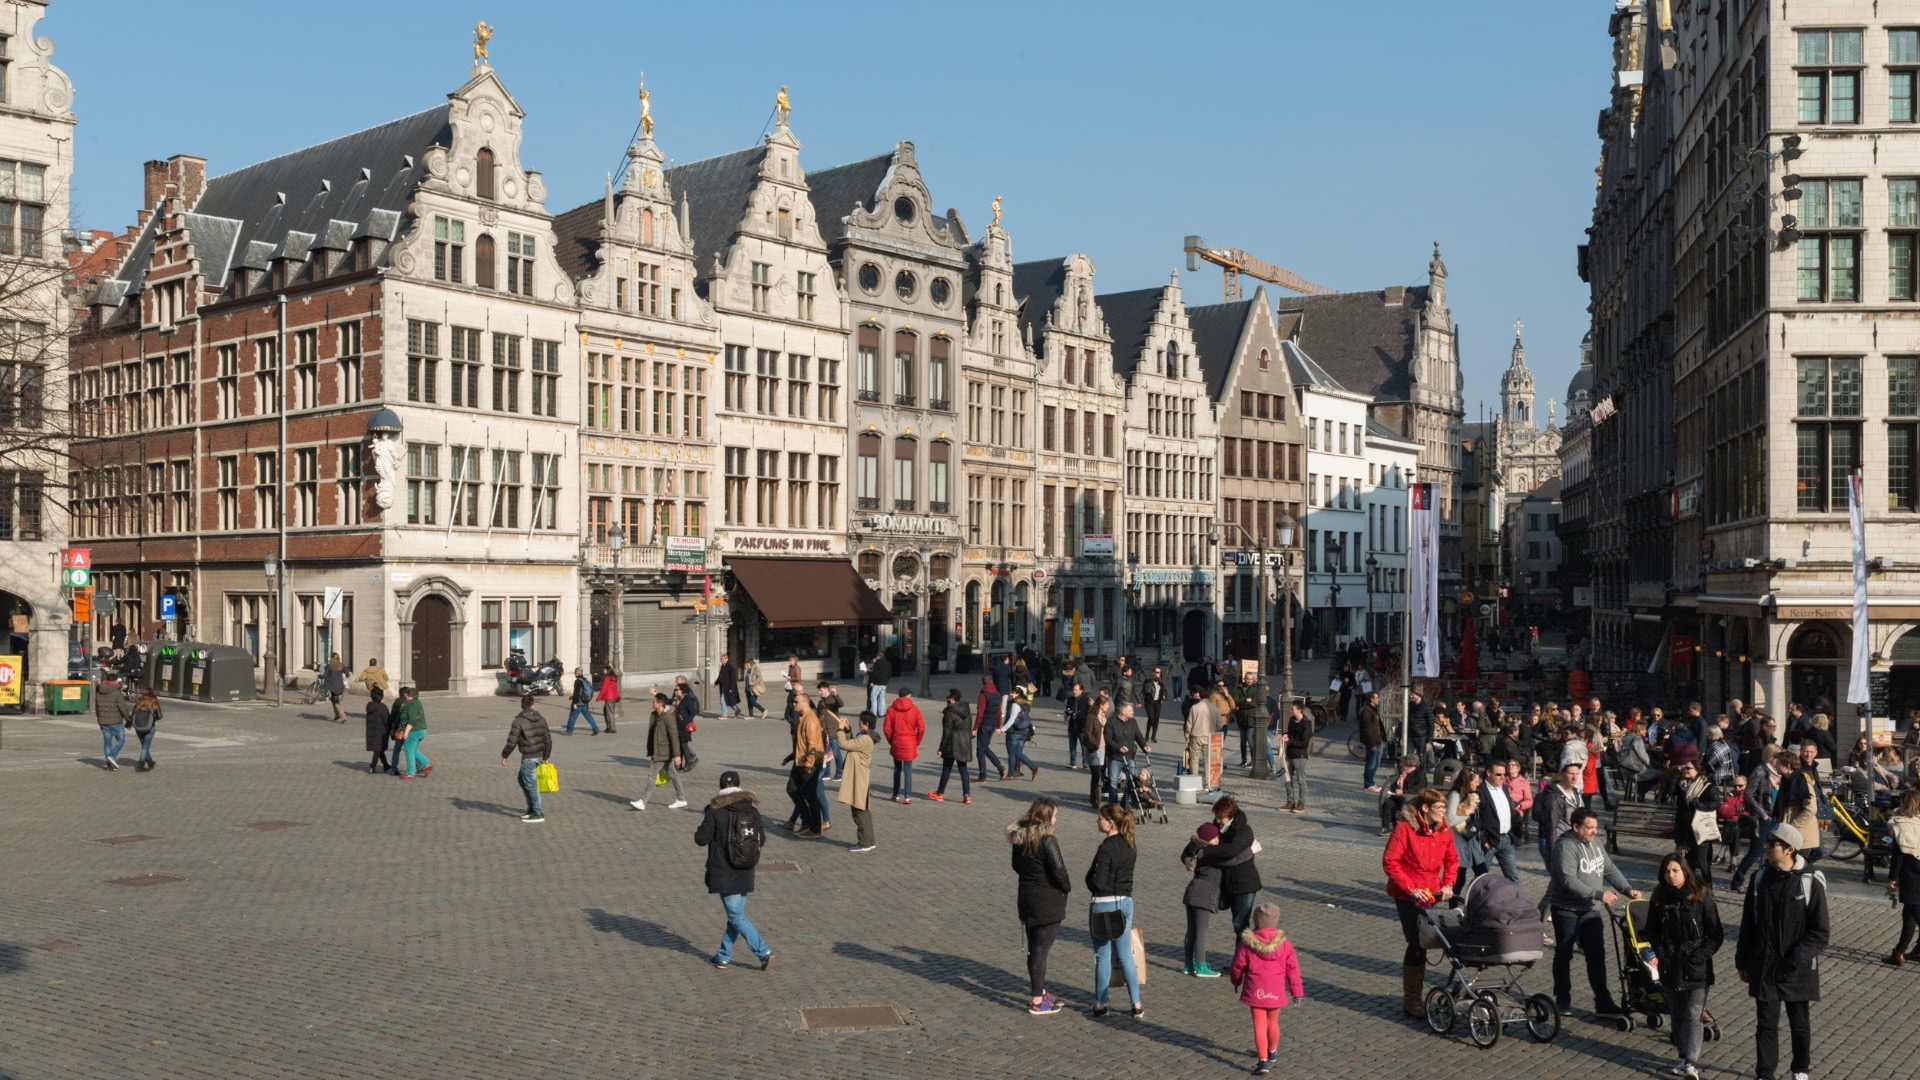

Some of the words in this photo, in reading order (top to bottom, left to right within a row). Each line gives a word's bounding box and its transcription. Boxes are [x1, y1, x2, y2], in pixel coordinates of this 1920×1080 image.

[1414, 492, 1420, 505] A
[873, 515, 948, 532] BONAPARTE
[734, 536, 790, 550] PARFUMS
[792, 539, 804, 550] IN
[807, 539, 831, 551] FINE
[74, 553, 85, 565] A
[1238, 552, 1286, 566] DIVECTY
[163, 598, 173, 611] P
